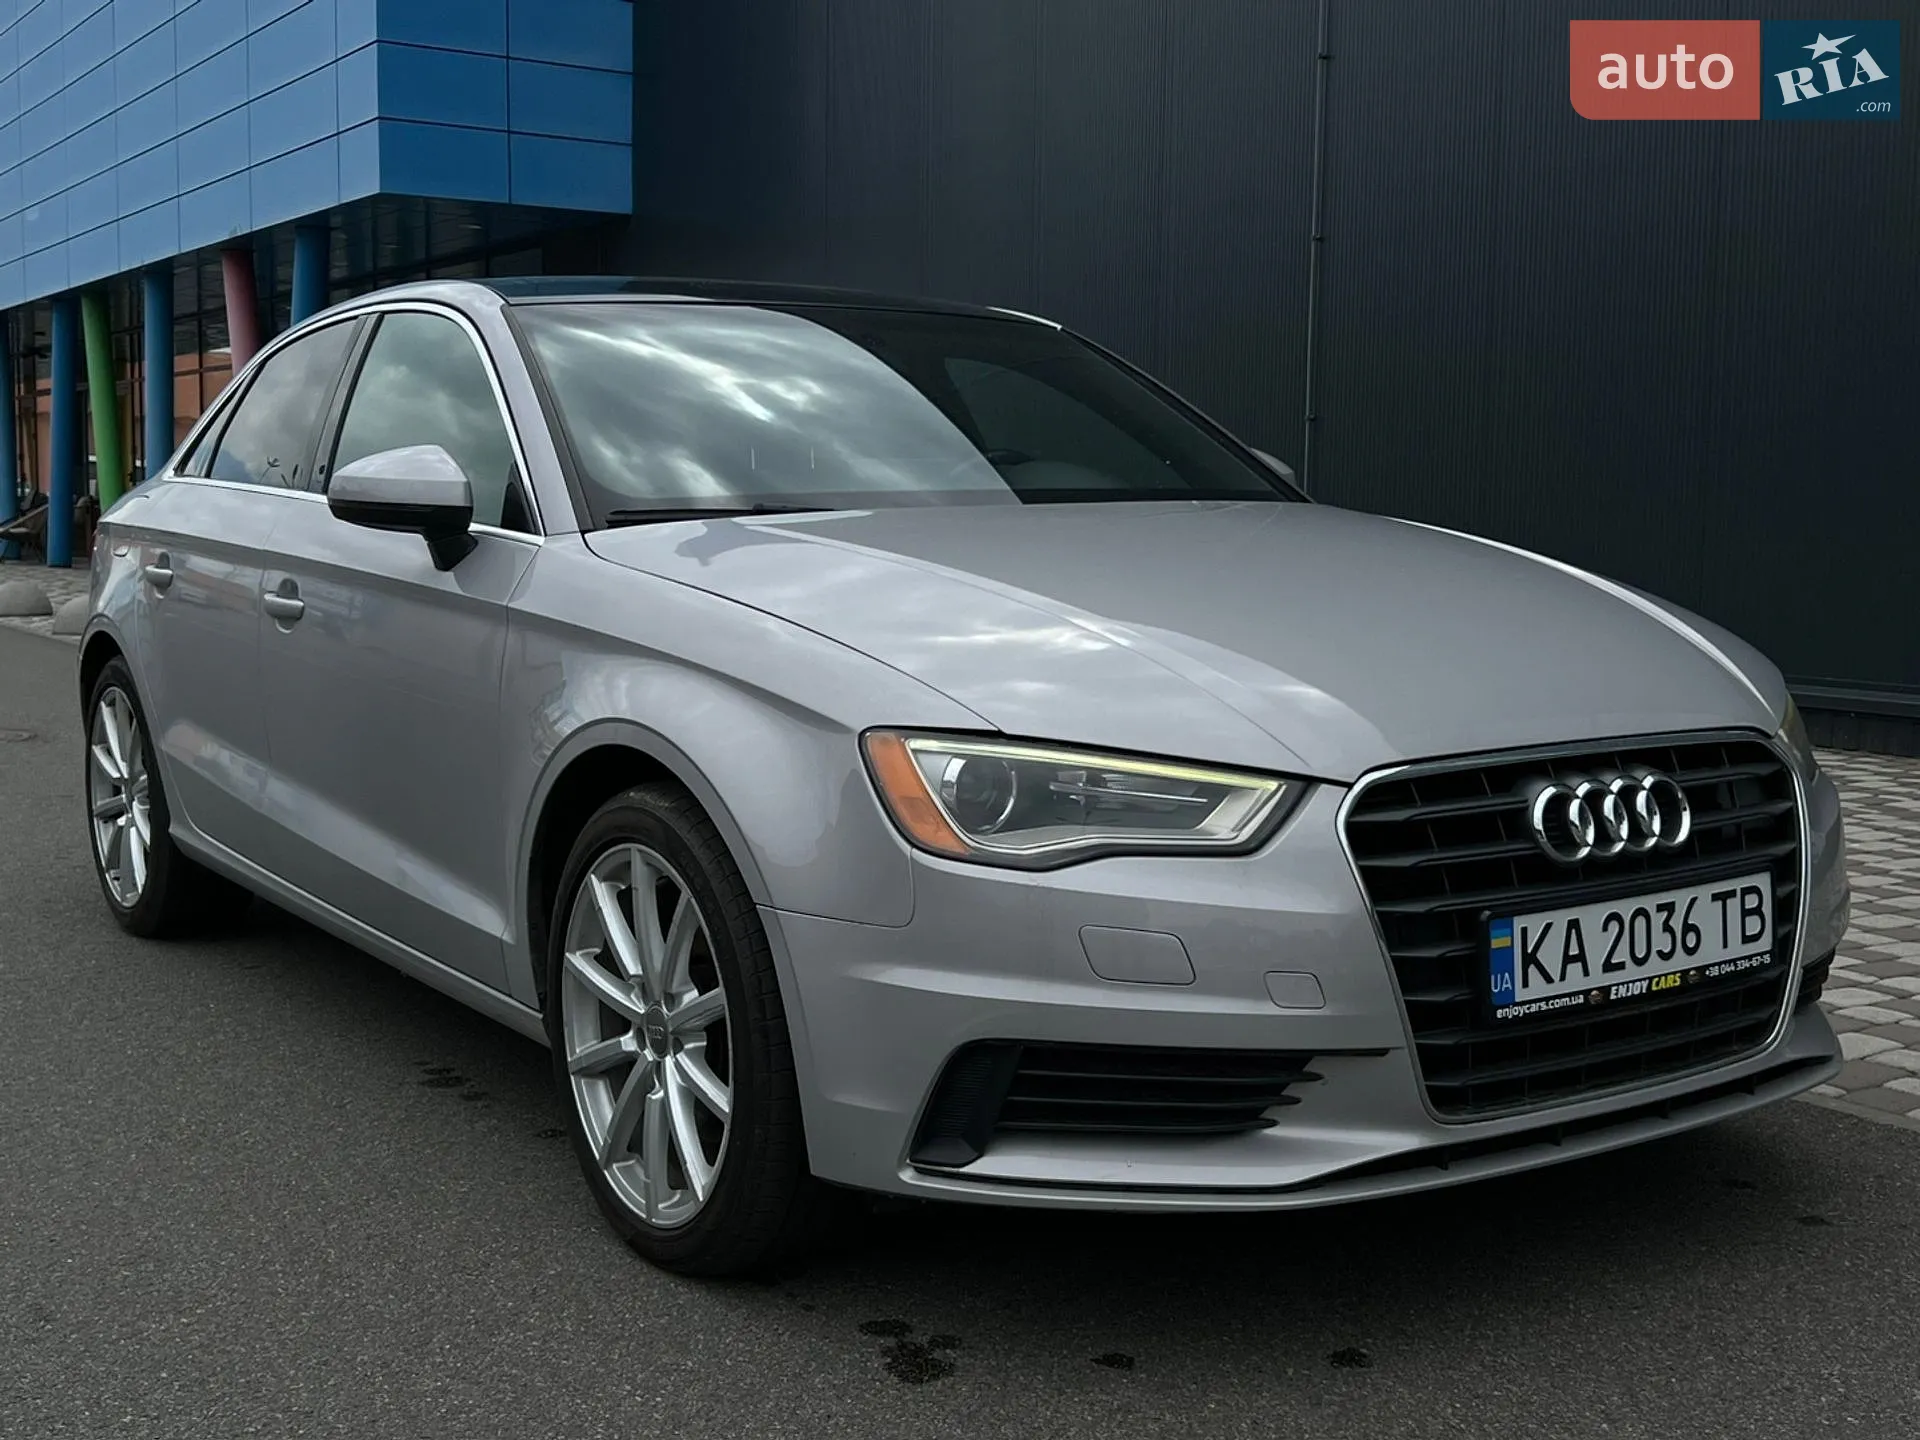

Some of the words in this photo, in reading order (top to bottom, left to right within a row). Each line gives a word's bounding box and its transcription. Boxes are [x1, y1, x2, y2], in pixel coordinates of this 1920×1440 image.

[1520, 917, 1591, 989] KA
[1601, 896, 1702, 974] 2036
[1711, 884, 1767, 950] TB
[1490, 972, 1513, 993] UA
[1609, 979, 1650, 1000] ENJOY
[1651, 973, 1682, 991] CARS
[1496, 994, 1585, 1019] enjoycars.com.ua
